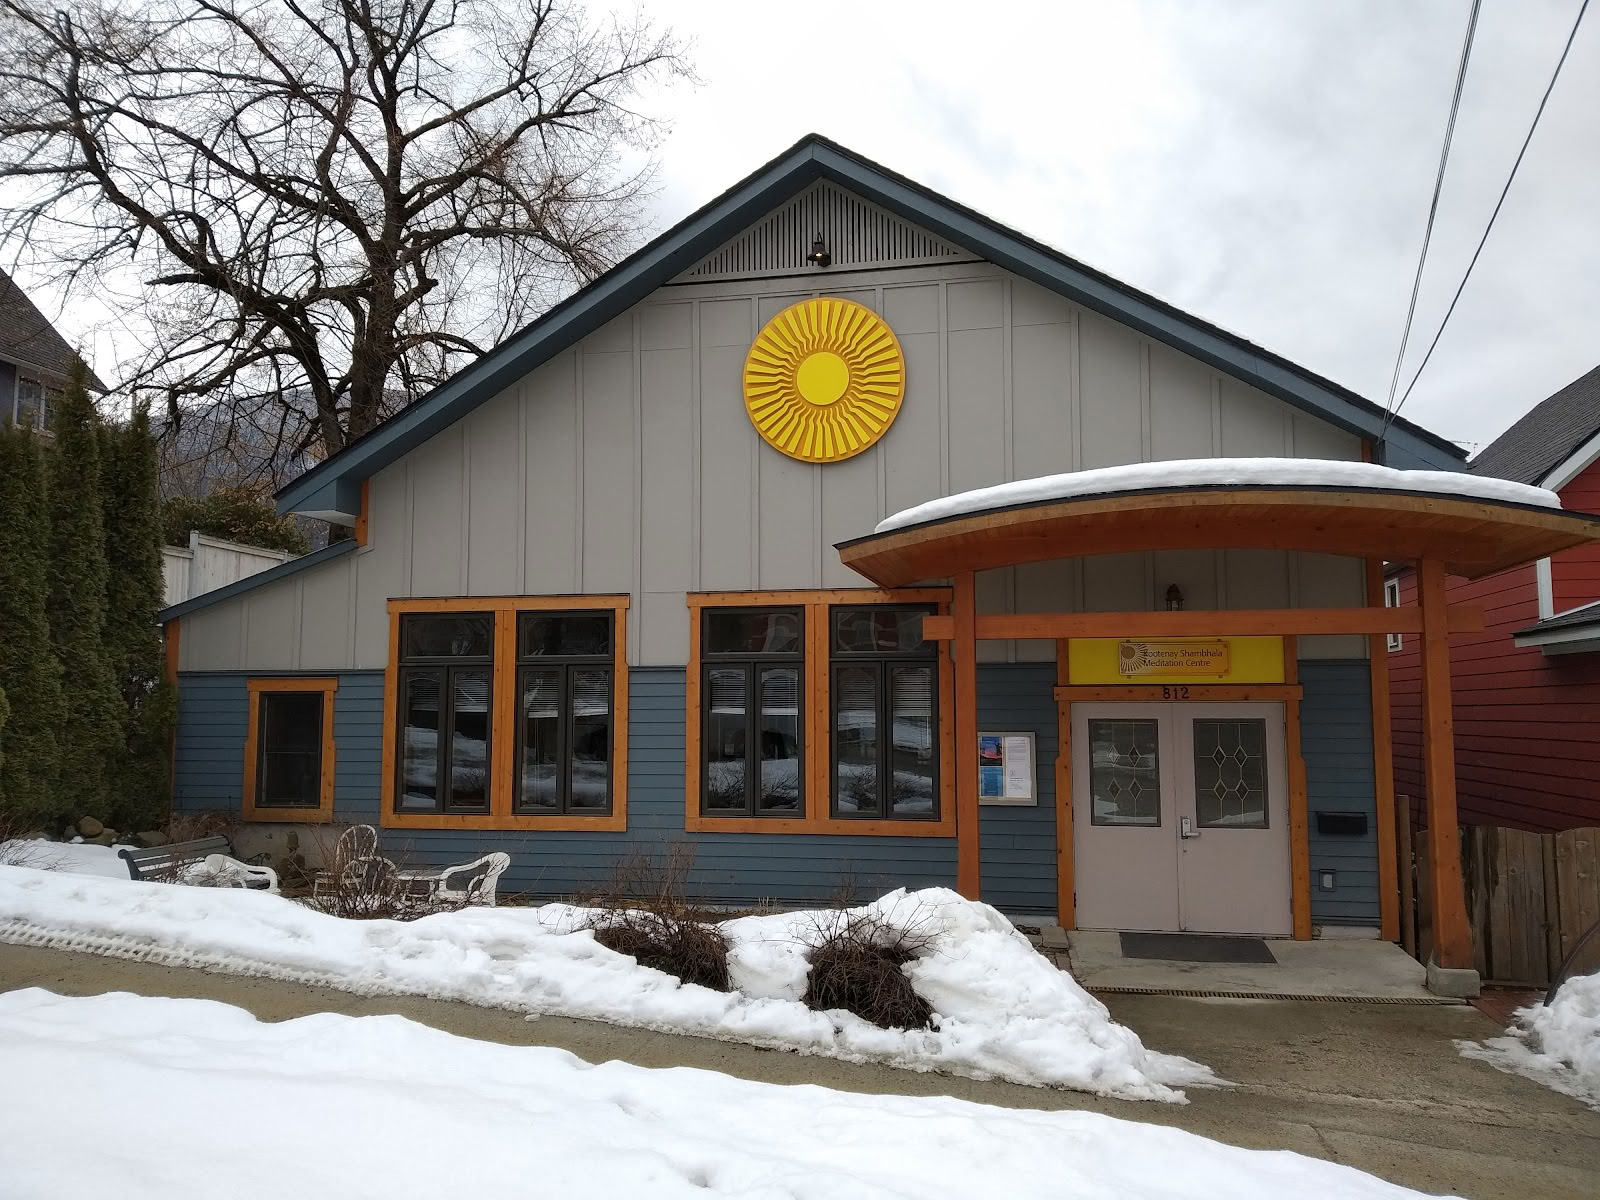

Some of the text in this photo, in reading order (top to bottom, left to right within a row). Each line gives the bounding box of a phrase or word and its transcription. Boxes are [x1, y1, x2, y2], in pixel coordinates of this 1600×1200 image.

[1143, 649, 1223, 659] Kootenay Shambhala
[1143, 659, 1211, 667] Meditation Centre
[1163, 687, 1190, 699] 812
